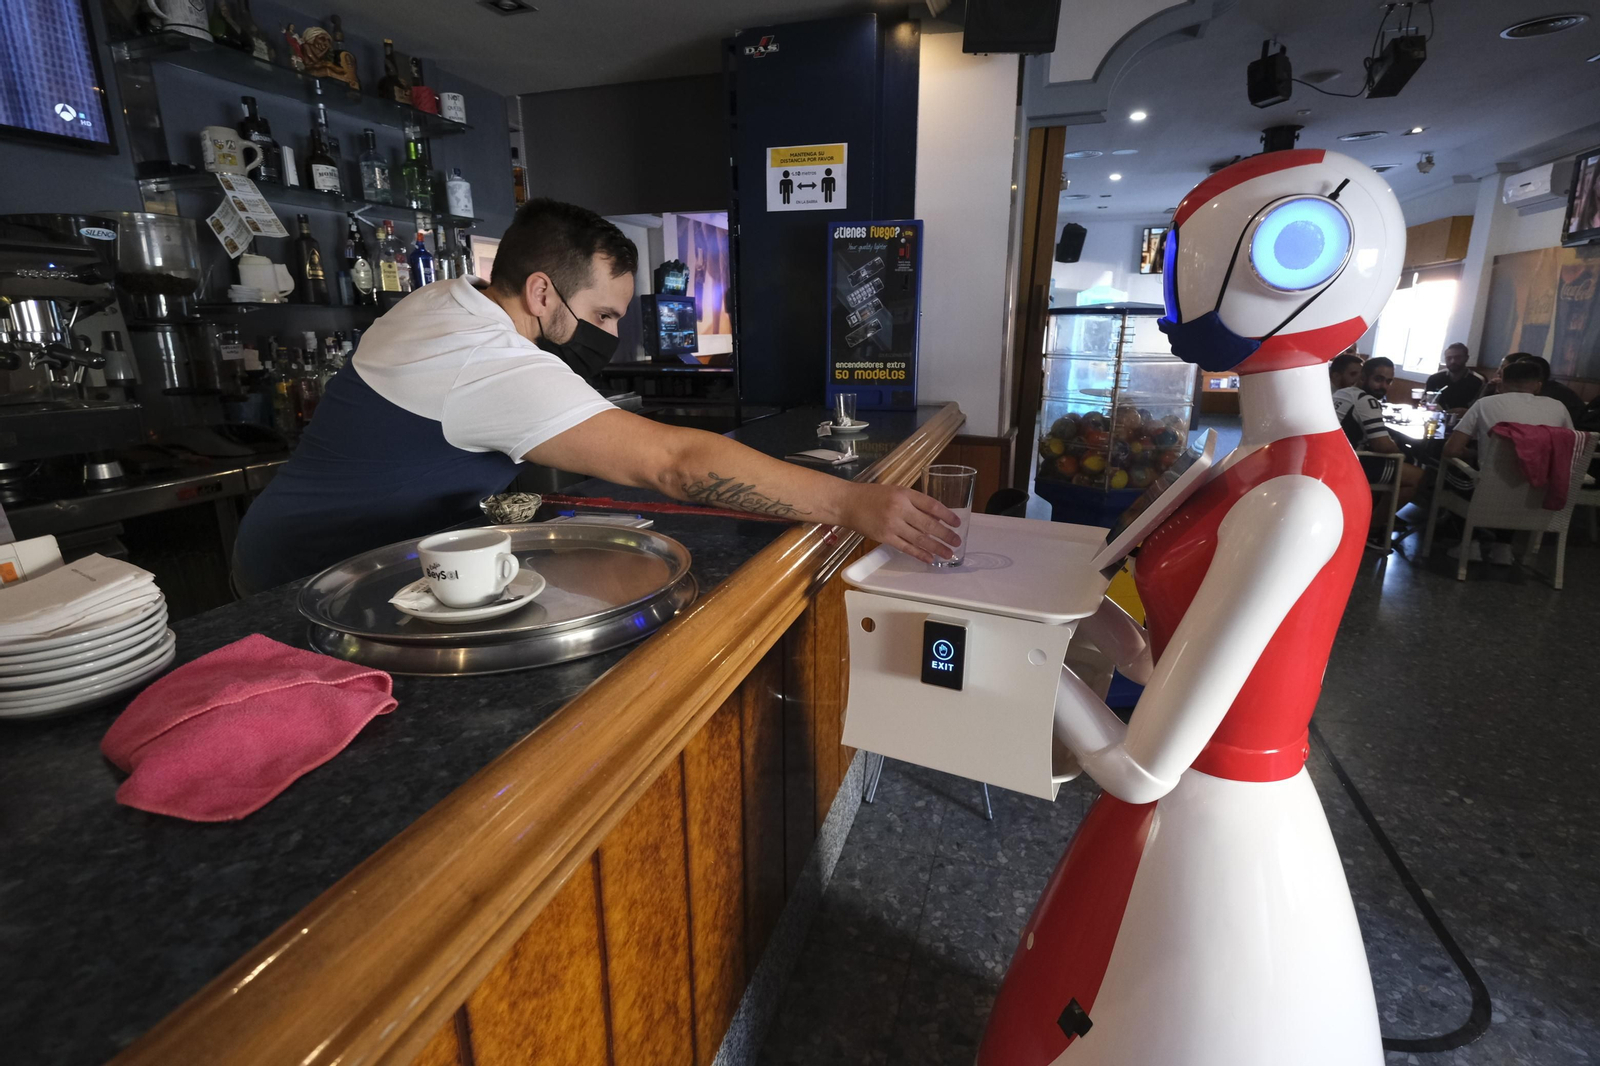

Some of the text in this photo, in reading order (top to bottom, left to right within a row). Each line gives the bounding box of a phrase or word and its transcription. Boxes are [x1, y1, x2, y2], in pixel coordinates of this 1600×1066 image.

[80, 119, 92, 127] HD
[835, 361, 906, 369] encendedores extra
[835, 368, 906, 380] 50 modelos
[681, 471, 813, 517] Alberto
[932, 661, 954, 672] EXIT
